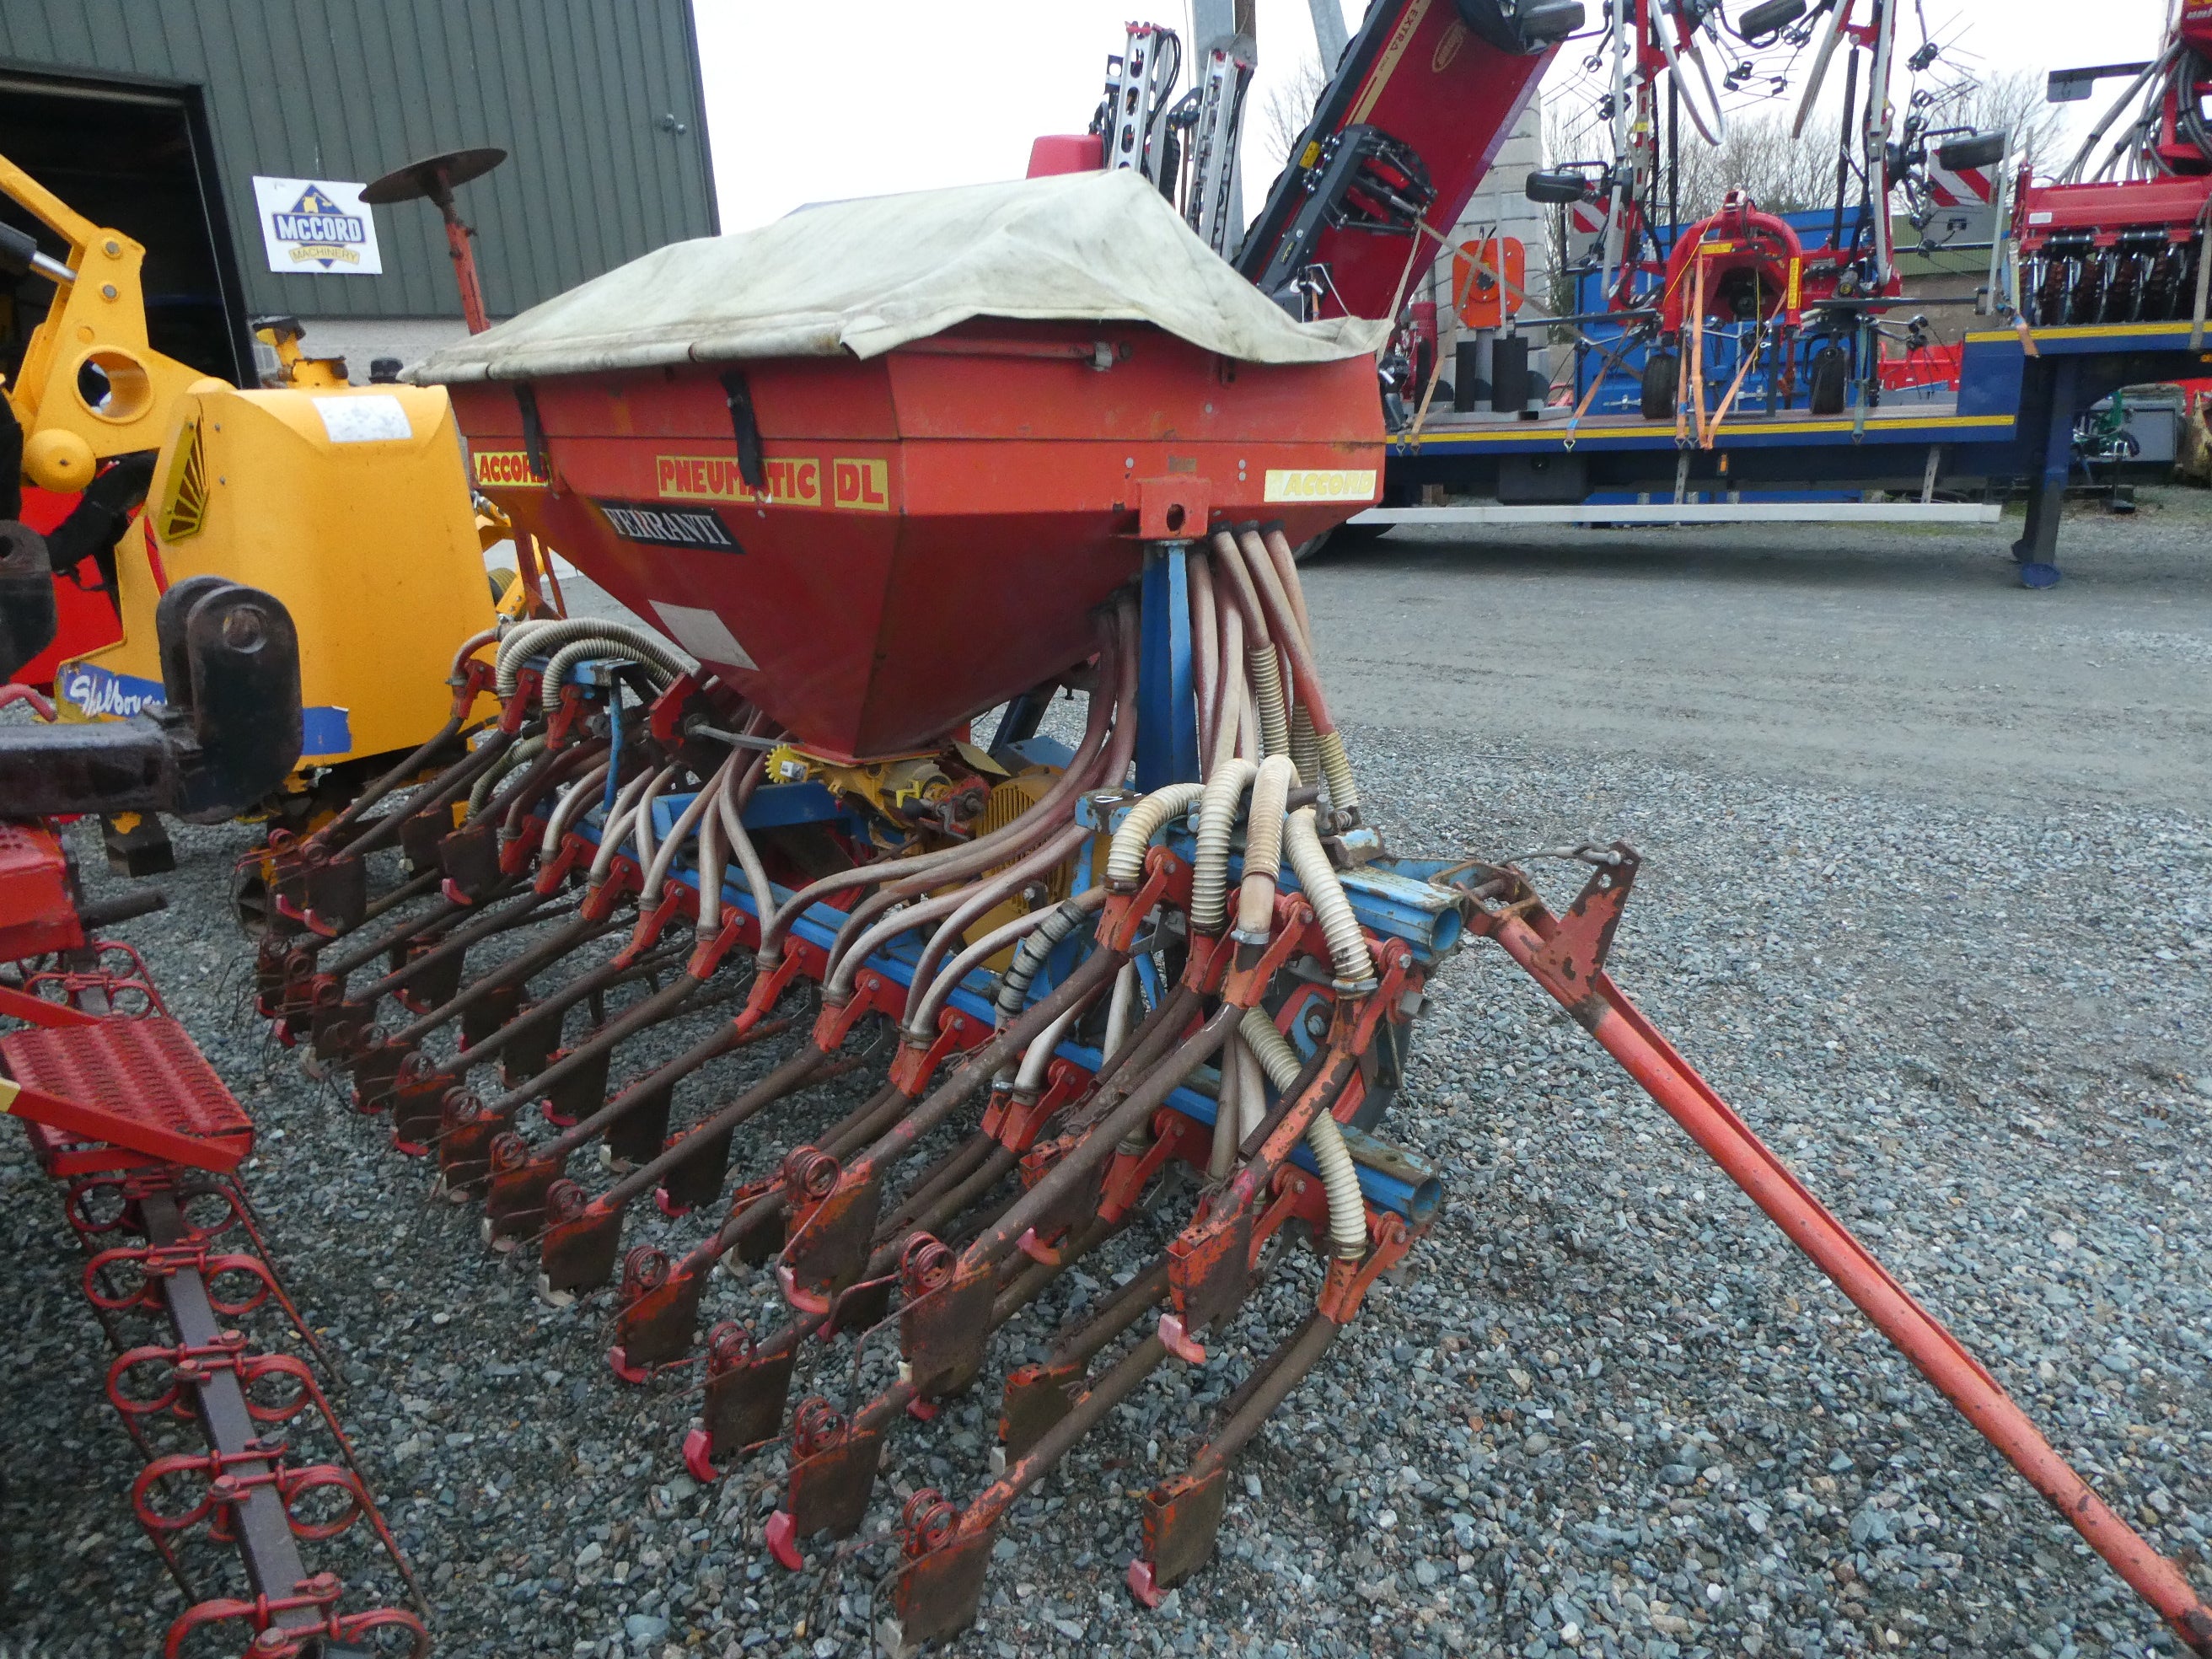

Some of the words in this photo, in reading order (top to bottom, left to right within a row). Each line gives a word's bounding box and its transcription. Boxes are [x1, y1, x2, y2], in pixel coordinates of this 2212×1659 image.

[293, 246, 358, 261] MACHINERY
[837, 463, 884, 504] DL
[1282, 472, 1375, 496] ACCORD
[601, 507, 732, 545] FERRANTI
